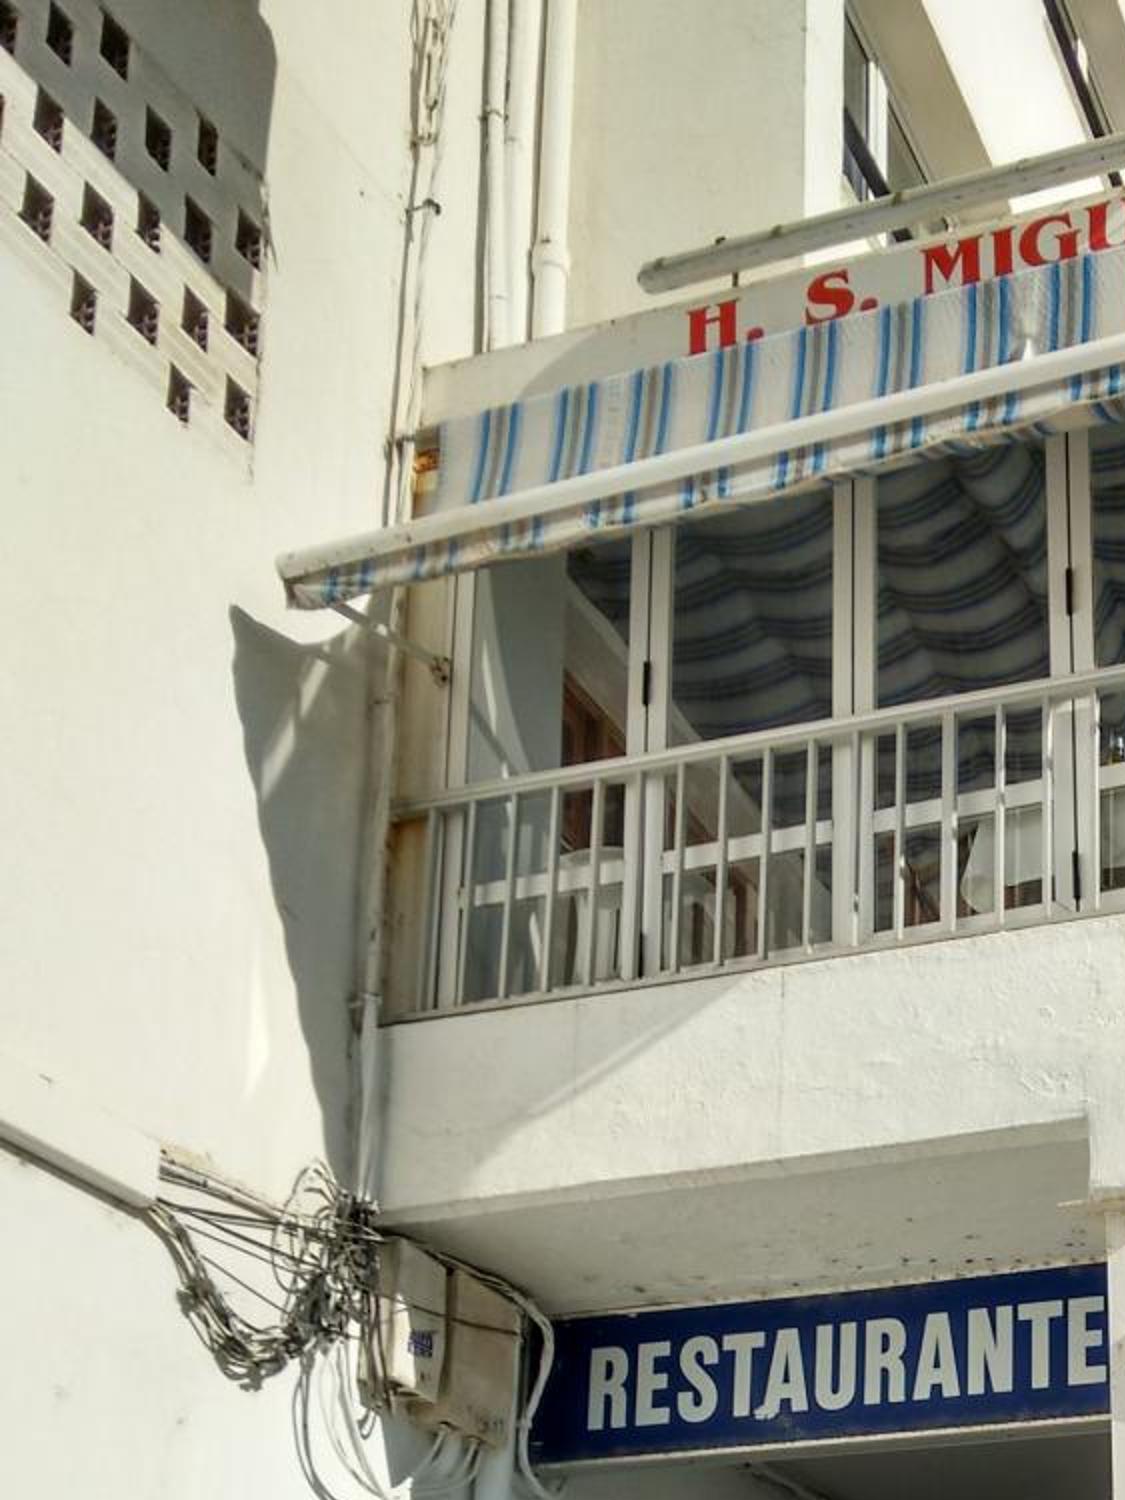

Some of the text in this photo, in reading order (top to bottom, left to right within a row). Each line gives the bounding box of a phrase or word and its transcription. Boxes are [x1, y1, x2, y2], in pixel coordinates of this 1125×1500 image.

[686, 297, 764, 356] H.
[805, 270, 878, 326] S.
[586, 1295, 1109, 1432] RESTAURANTE
